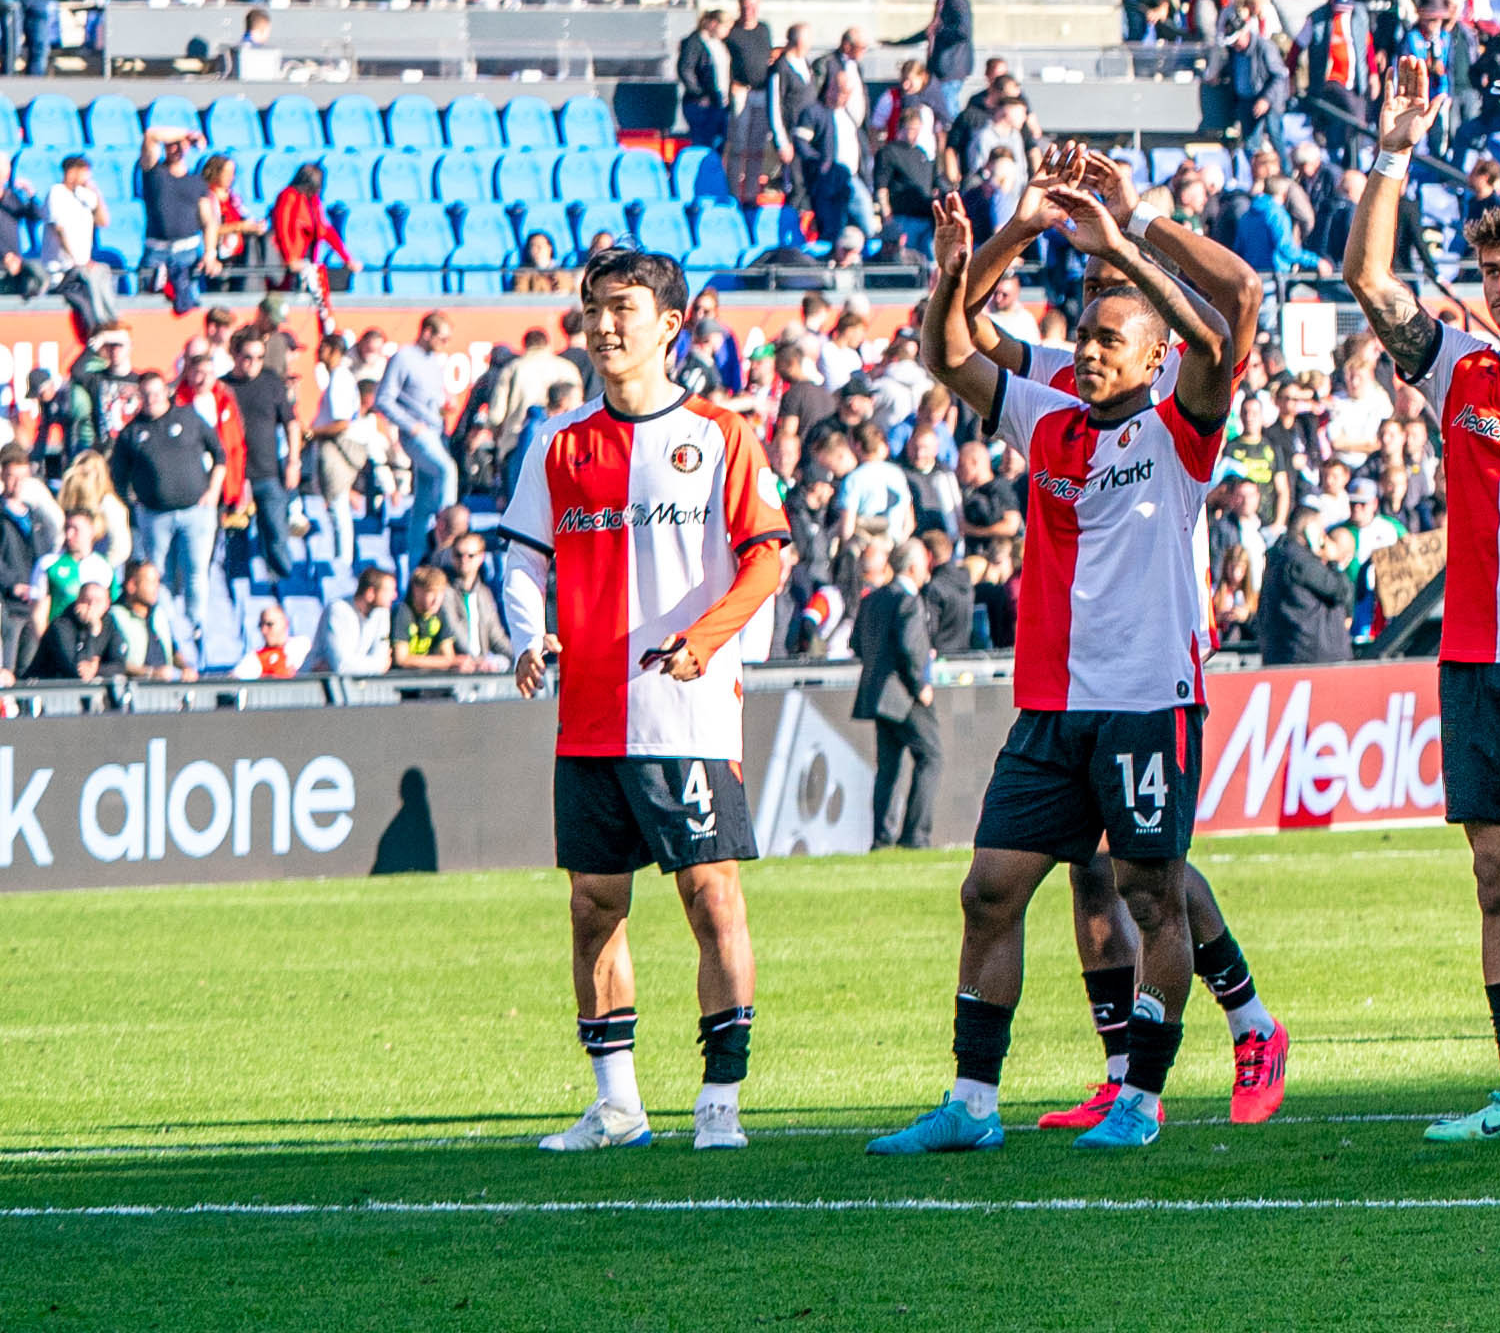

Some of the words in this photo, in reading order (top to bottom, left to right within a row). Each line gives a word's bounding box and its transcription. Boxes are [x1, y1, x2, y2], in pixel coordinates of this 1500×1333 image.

[1301, 321, 1318, 356] L
[556, 507, 625, 535] Media
[645, 502, 711, 525] Markt
[1116, 751, 1169, 808] 14
[1195, 680, 1446, 823] Media
[79, 737, 356, 864] alone
[682, 759, 714, 814] 4
